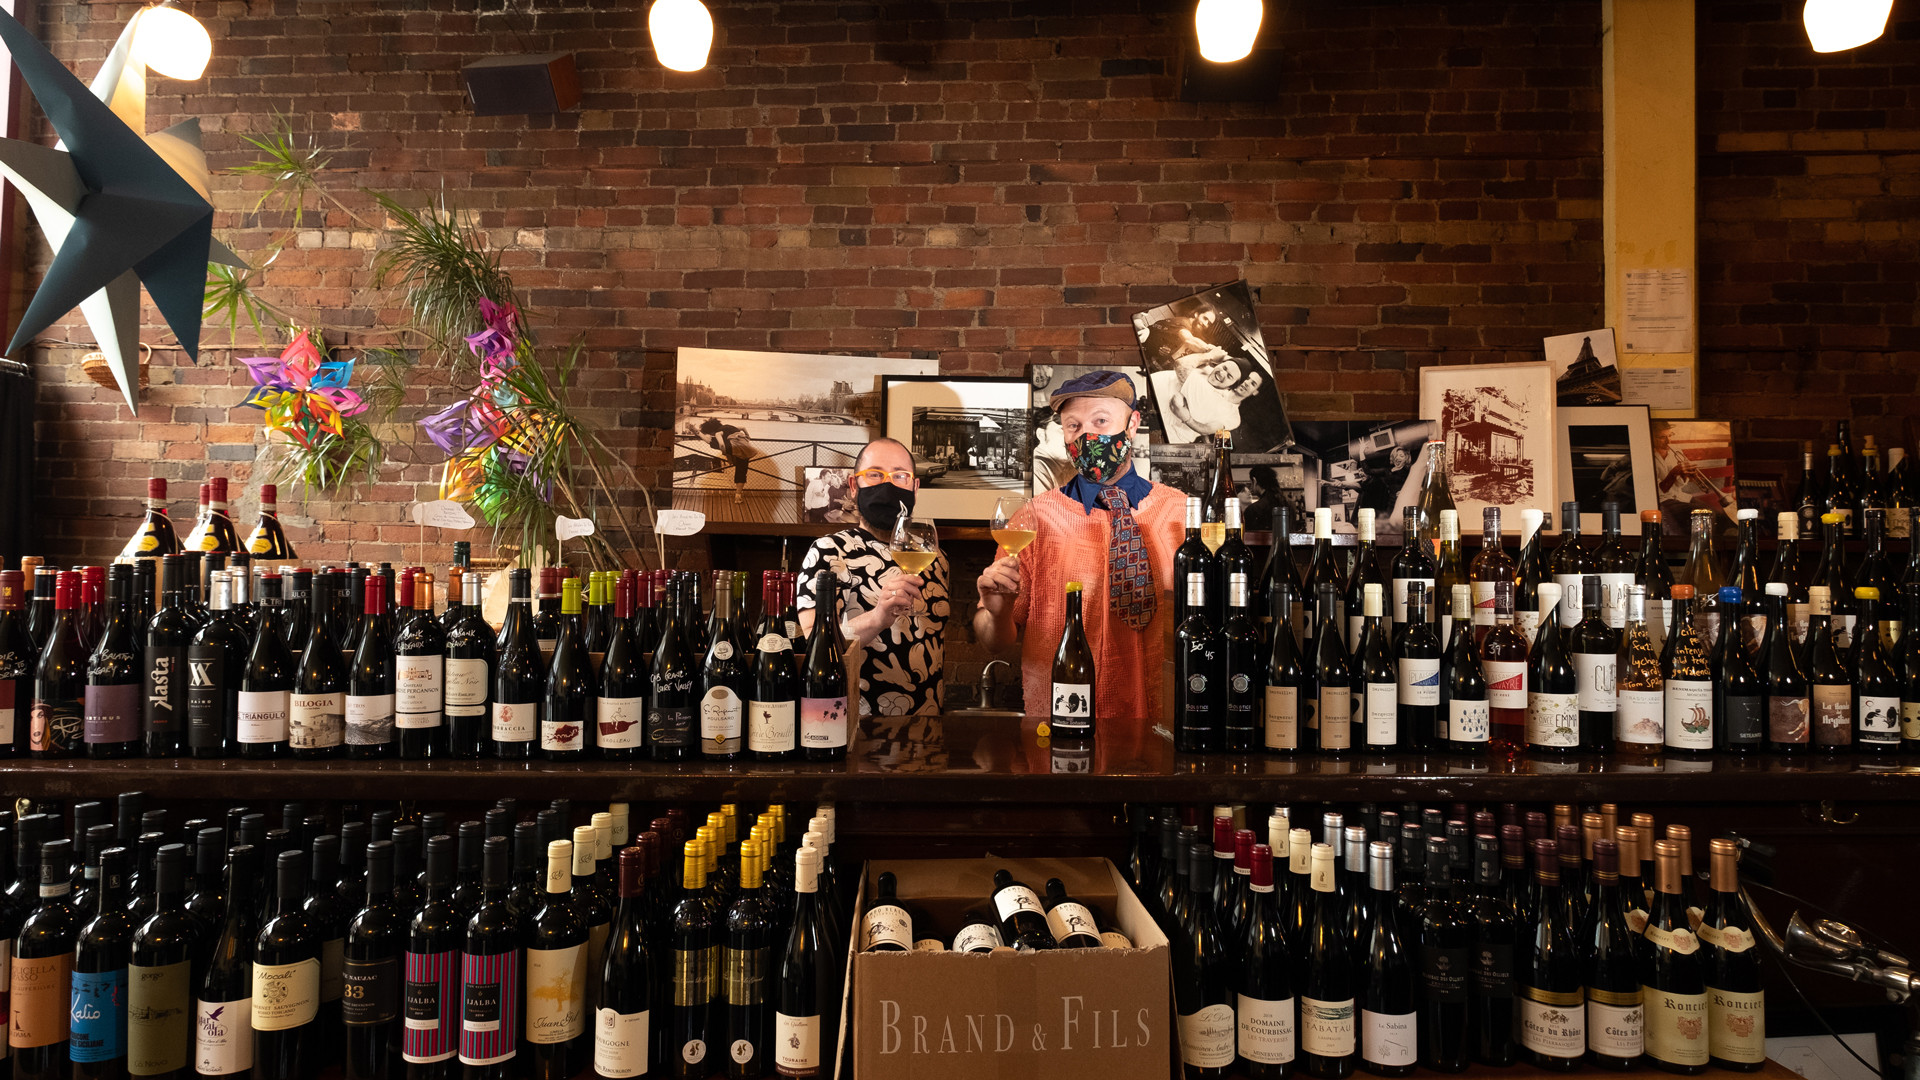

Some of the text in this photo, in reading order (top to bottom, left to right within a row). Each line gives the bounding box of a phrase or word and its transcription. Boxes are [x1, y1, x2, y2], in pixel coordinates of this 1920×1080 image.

[1204, 650, 1216, 660] 45
[294, 700, 334, 708] BILOGIA
[344, 984, 364, 999] 33
[408, 996, 436, 1004] IJALBA
[1714, 994, 1762, 1010] Roncier
[879, 996, 1150, 1054] BRAND & FILS
[1250, 1018, 1286, 1026] DOMAINE
[208, 1026, 224, 1036] ola
[1251, 1026, 1292, 1036] COURBISSAC
[1304, 1022, 1352, 1033] TABATAU
[1524, 1020, 1544, 1033] Côtes
[1548, 1026, 1558, 1036] du
[1605, 1026, 1628, 1036] Côtes
